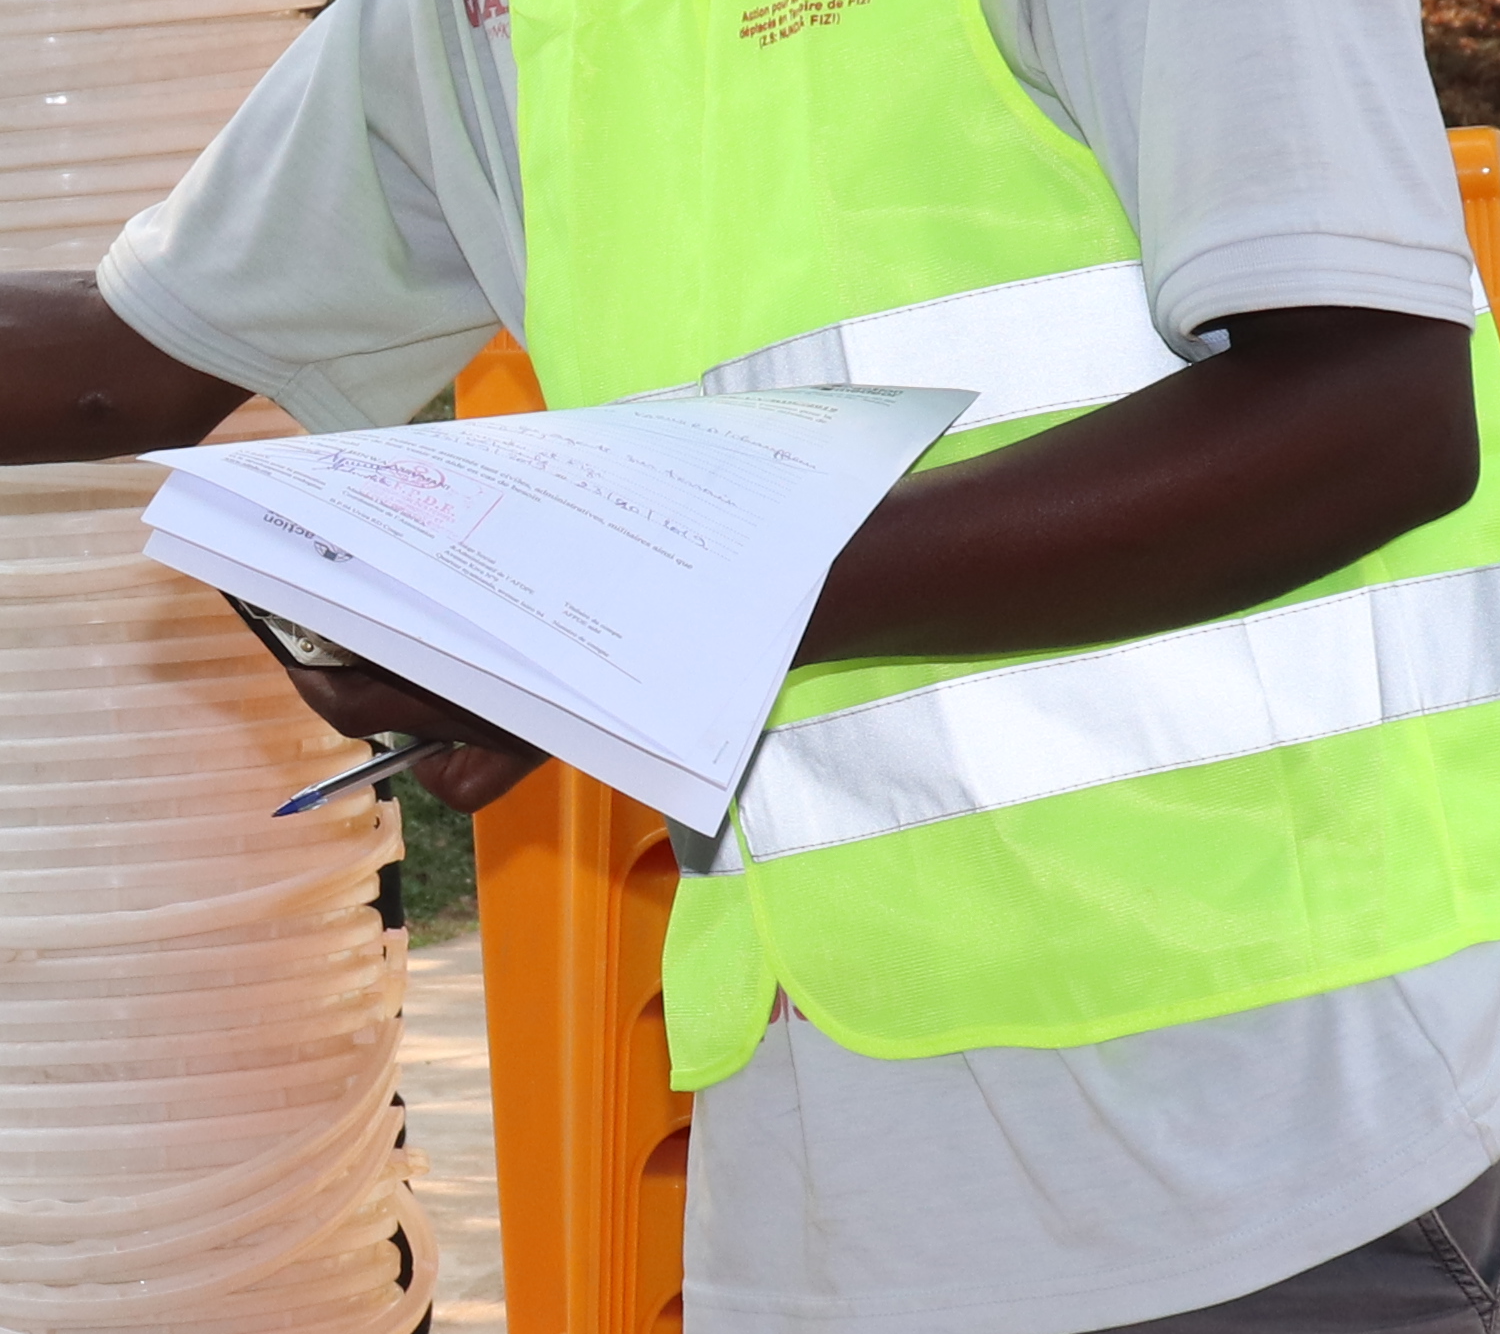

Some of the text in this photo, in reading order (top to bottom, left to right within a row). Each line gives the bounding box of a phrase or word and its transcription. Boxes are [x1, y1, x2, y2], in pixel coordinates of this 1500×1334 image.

[262, 512, 316, 540] action
[532, 484, 606, 524] administratives,
[606, 519, 651, 549] militaires
[651, 542, 676, 561] ainsi
[673, 555, 694, 571] que
